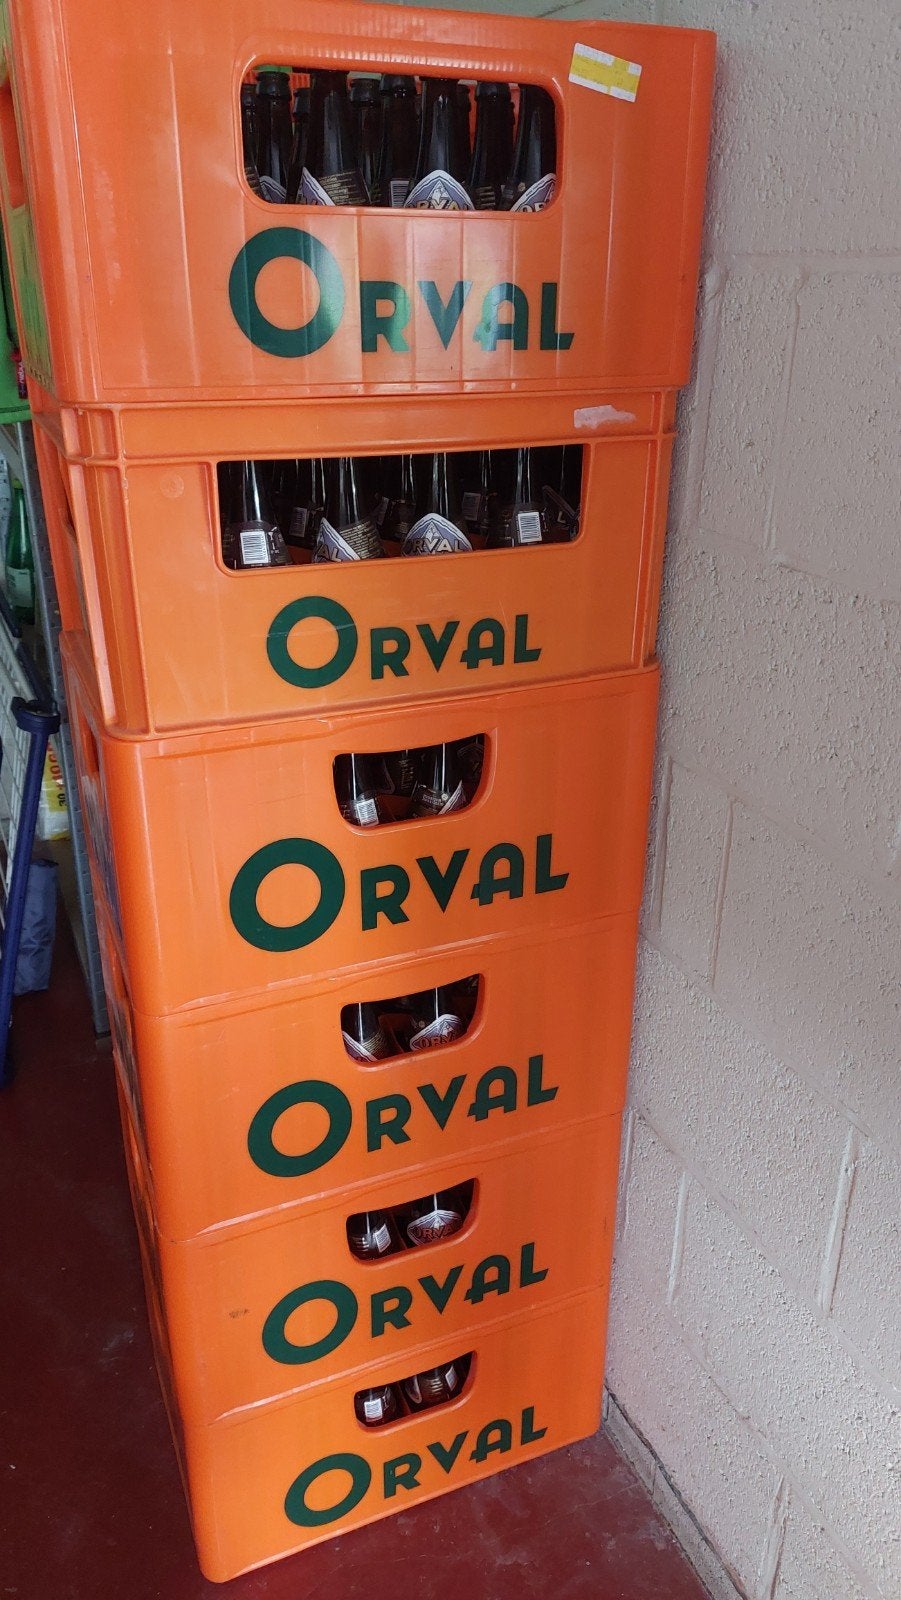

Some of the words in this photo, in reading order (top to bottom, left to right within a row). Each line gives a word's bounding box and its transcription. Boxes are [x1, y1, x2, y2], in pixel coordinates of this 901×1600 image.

[229, 227, 575, 358] ORVAL
[267, 596, 542, 689] ORVAL
[229, 834, 569, 952] ORVAL
[247, 1055, 559, 1177] ORVAL
[262, 1243, 549, 1365] ORVAL
[285, 1407, 548, 1528] ORVAL
